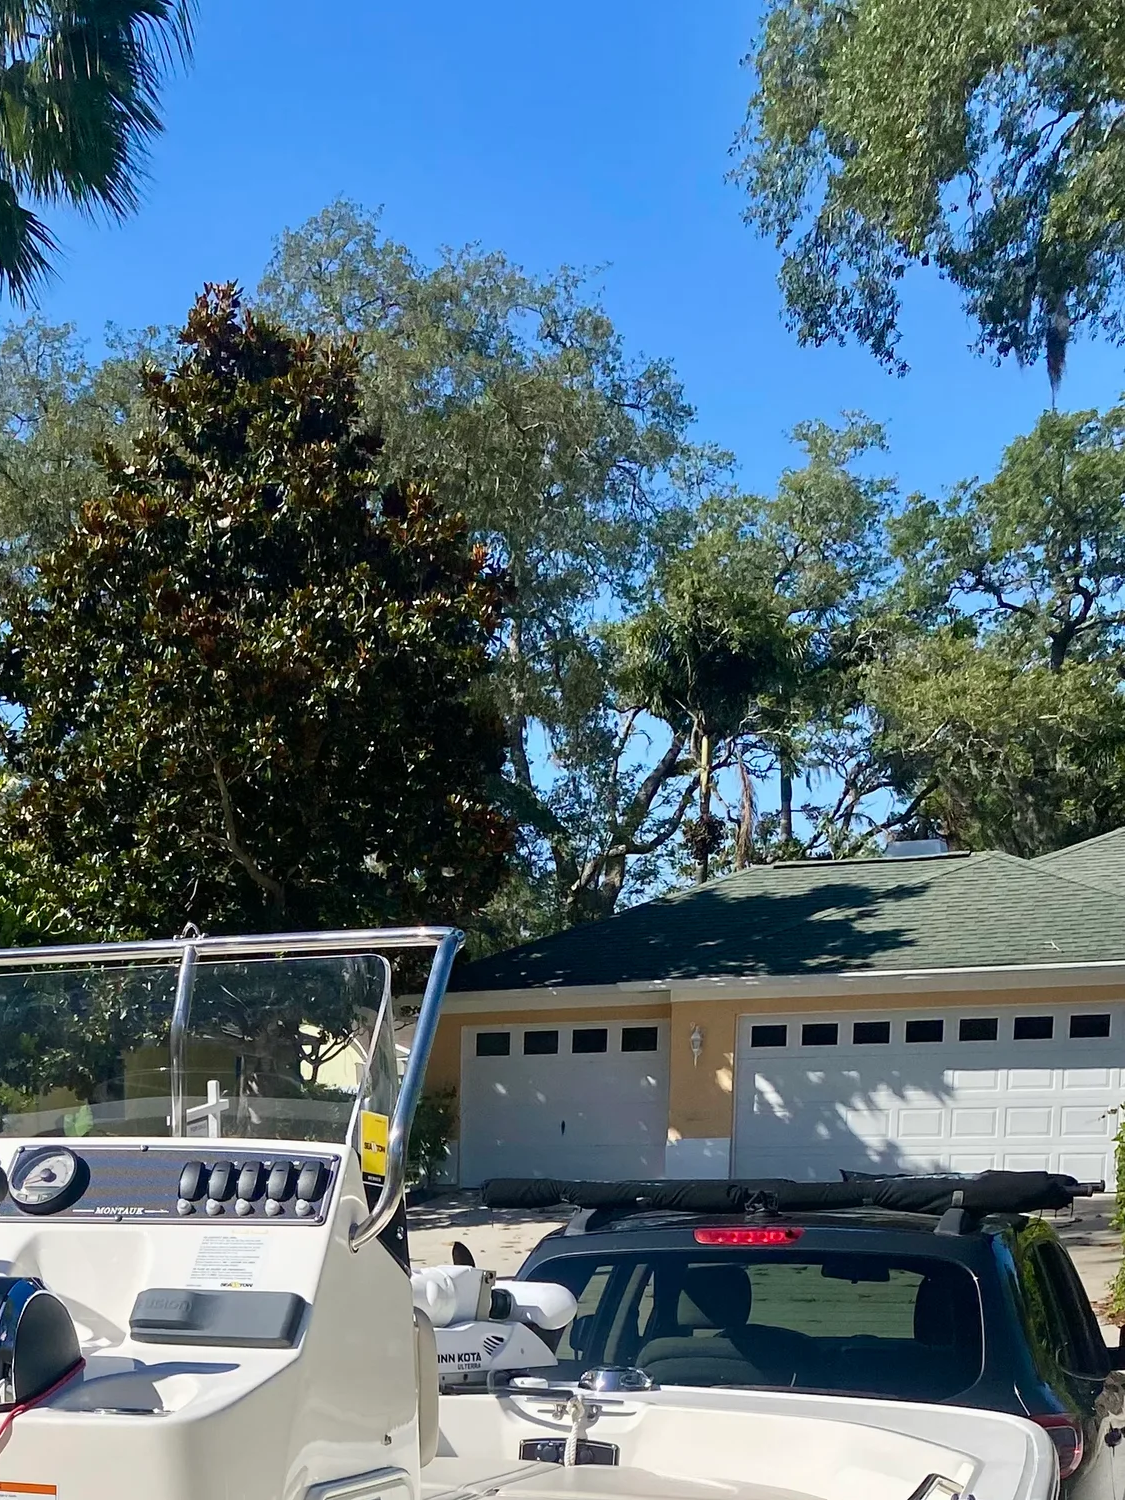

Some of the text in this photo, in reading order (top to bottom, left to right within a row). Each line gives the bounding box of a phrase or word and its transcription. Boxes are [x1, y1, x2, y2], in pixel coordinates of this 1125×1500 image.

[94, 1206, 145, 1215] MONTAUK
[438, 1352, 482, 1364] INN KOTA
